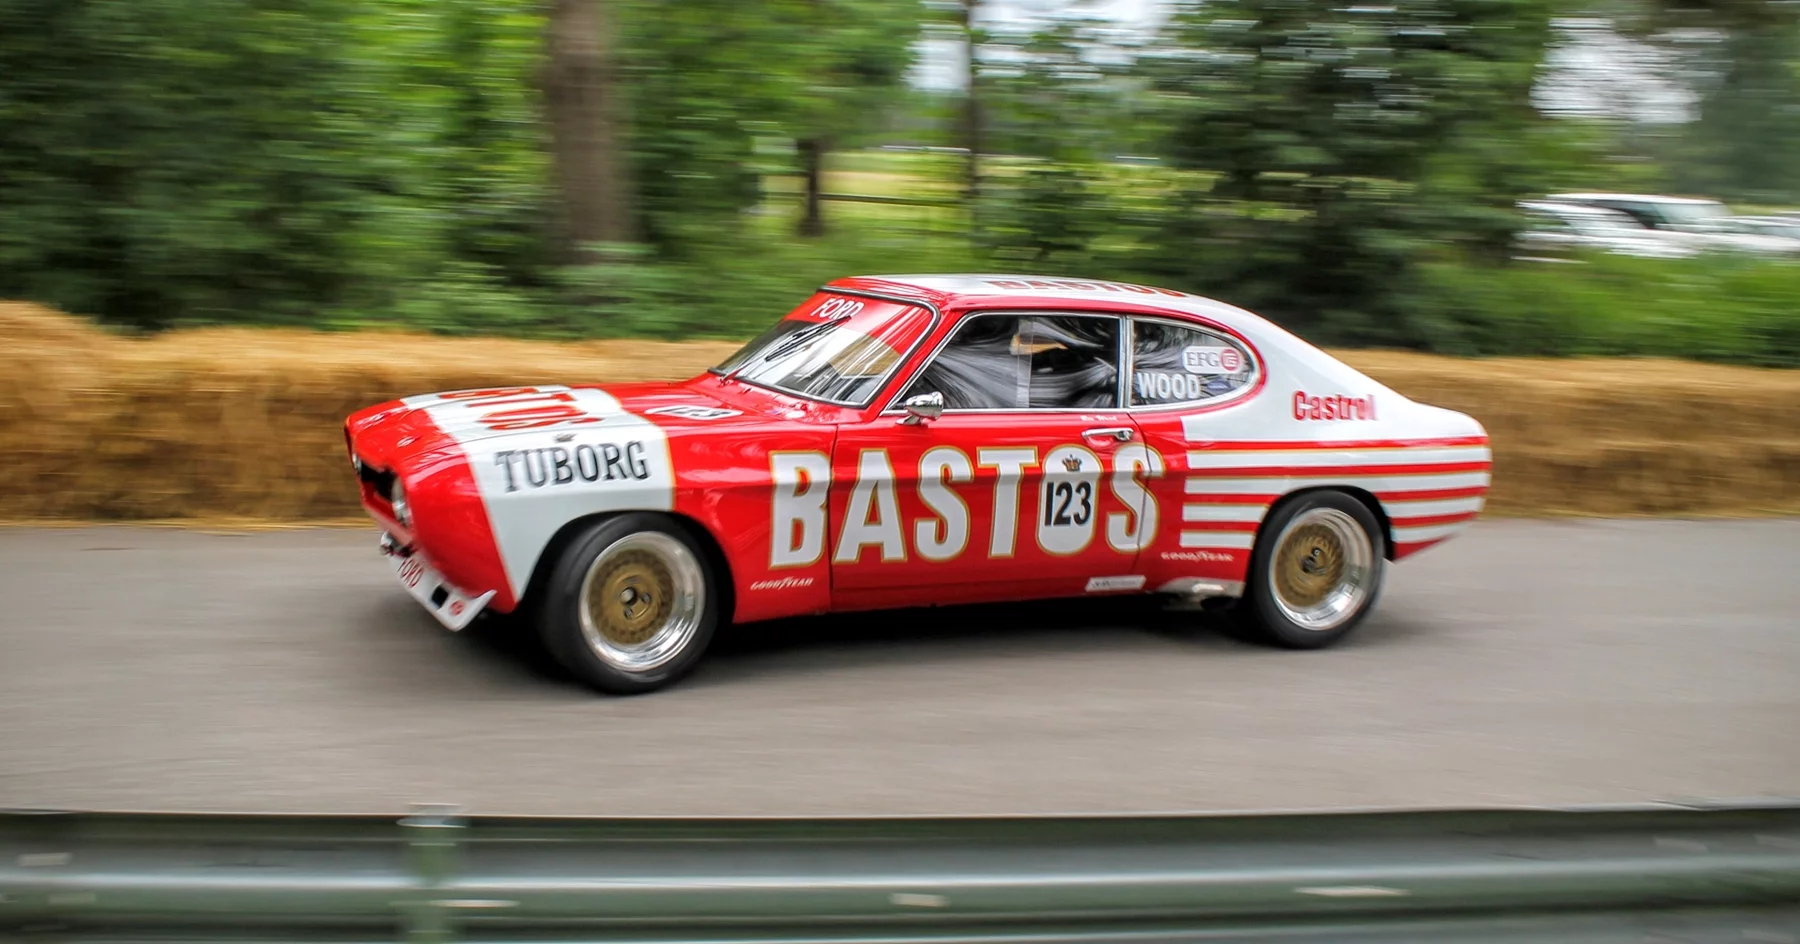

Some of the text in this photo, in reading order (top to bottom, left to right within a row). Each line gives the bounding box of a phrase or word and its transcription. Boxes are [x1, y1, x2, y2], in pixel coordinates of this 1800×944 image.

[810, 298, 865, 320] FORD
[1186, 351, 1219, 367] EFG
[1136, 372, 1200, 400] WOOD
[1293, 389, 1378, 421] Castrol
[494, 440, 650, 493] TUBORG
[768, 443, 1165, 570] BASTOS
[1043, 481, 1093, 528] 123
[396, 558, 424, 589] FORD
